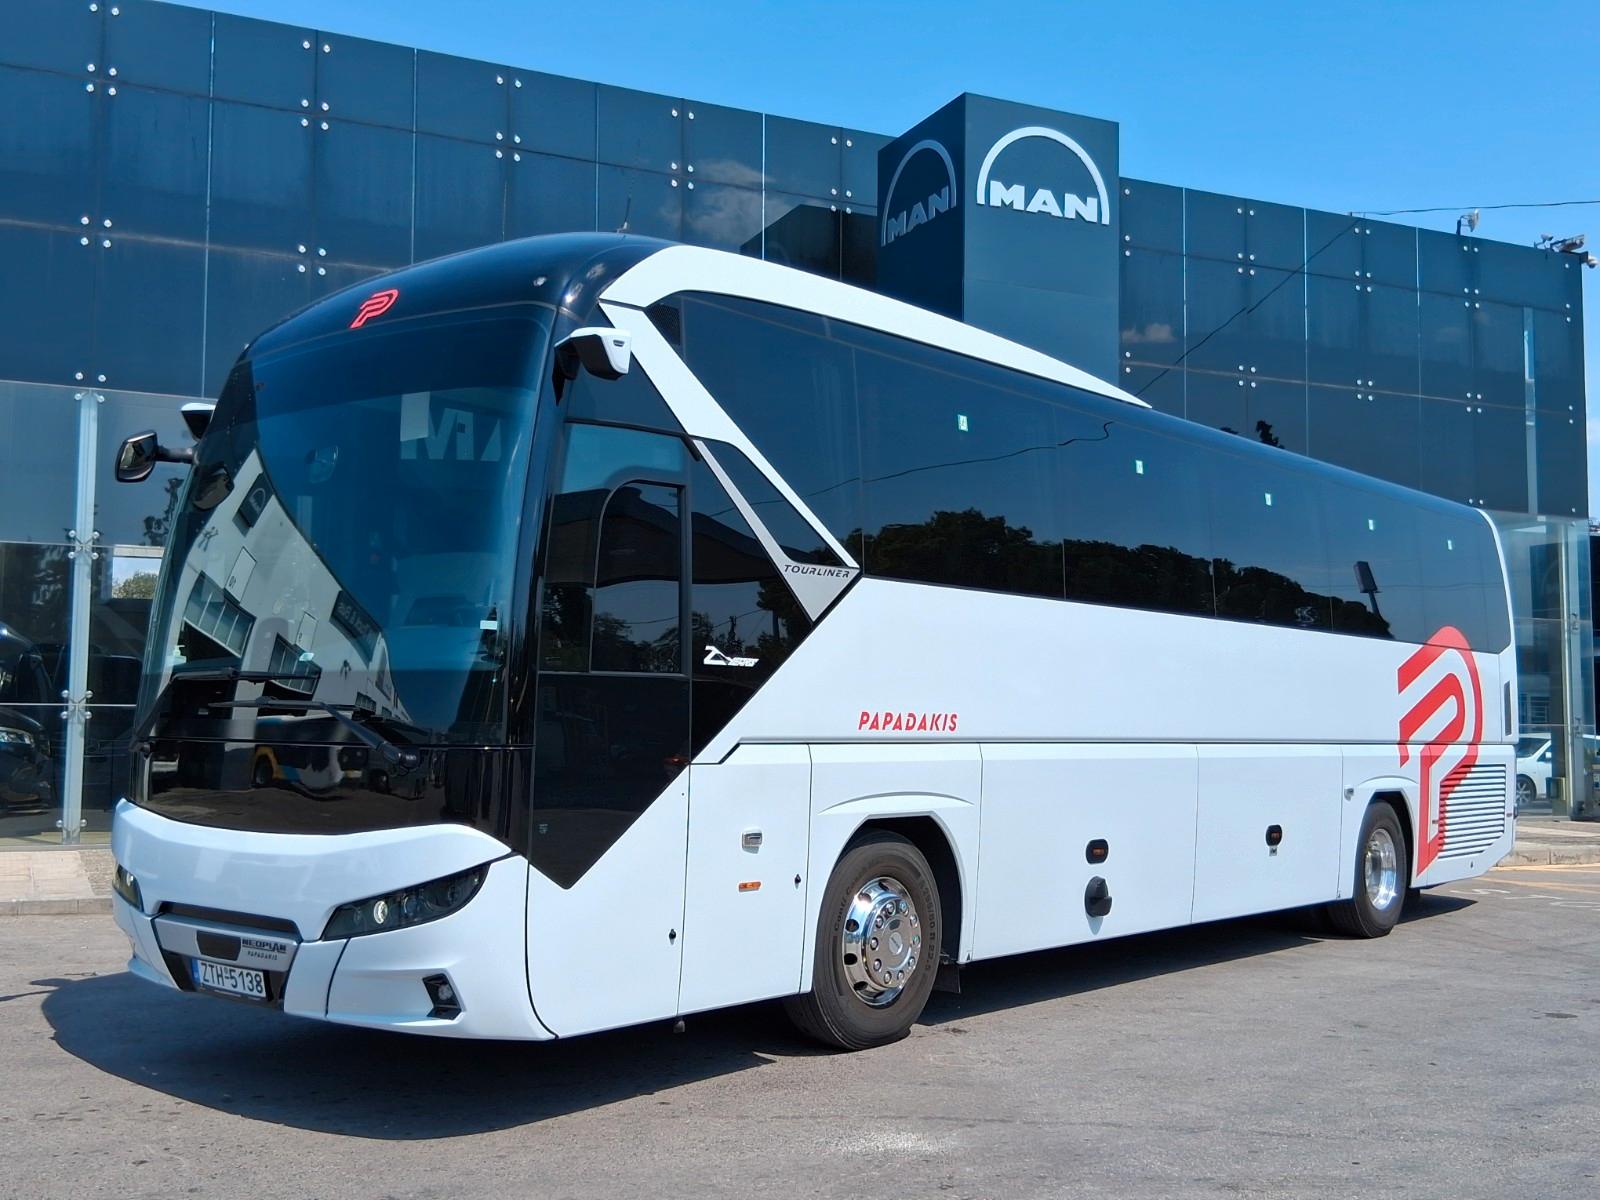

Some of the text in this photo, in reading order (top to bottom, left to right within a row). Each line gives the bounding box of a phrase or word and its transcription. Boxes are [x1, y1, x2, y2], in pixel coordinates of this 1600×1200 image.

[887, 185, 949, 243] MAN
[989, 180, 1098, 223] MAN
[784, 565, 850, 578] TOURLINER
[858, 712, 958, 731] PAPADAKIS
[201, 962, 263, 994] ZTH-5138
